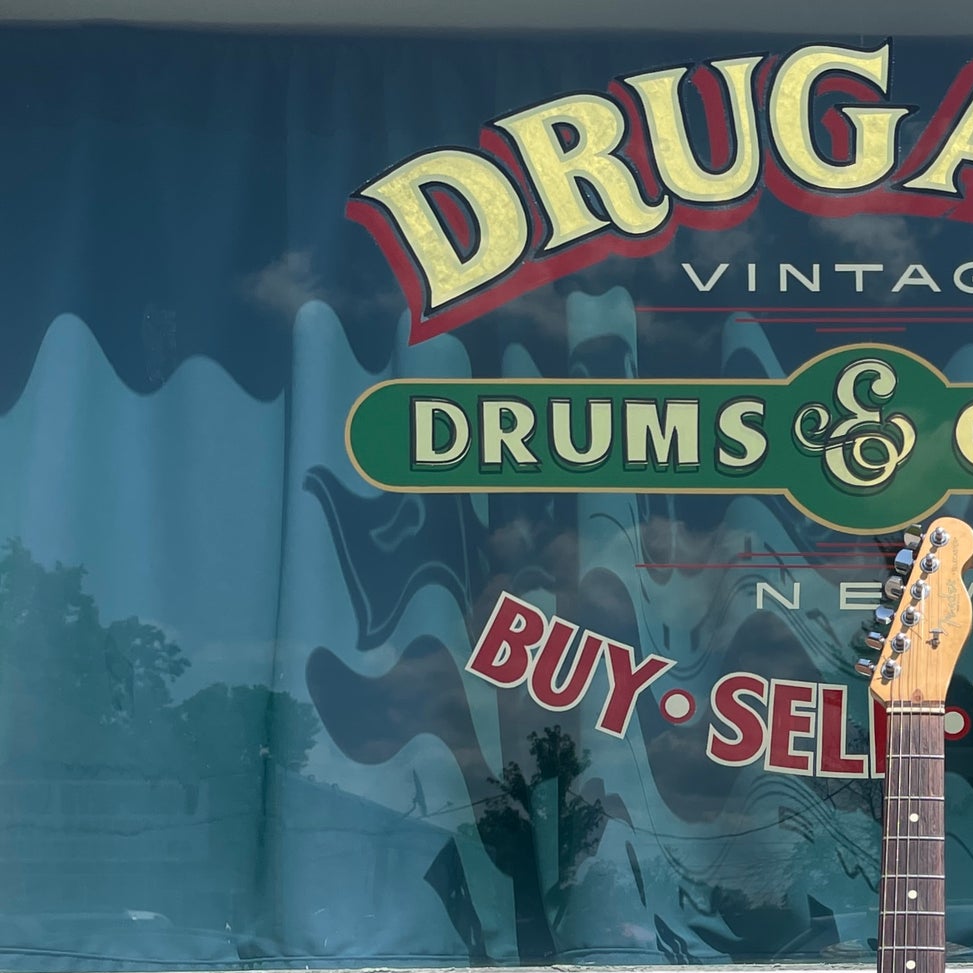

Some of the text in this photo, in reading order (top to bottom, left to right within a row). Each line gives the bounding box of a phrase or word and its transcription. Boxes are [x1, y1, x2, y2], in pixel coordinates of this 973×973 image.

[410, 398, 769, 472] DRUMS
[794, 358, 917, 492] &
[465, 591, 679, 740] BUY
